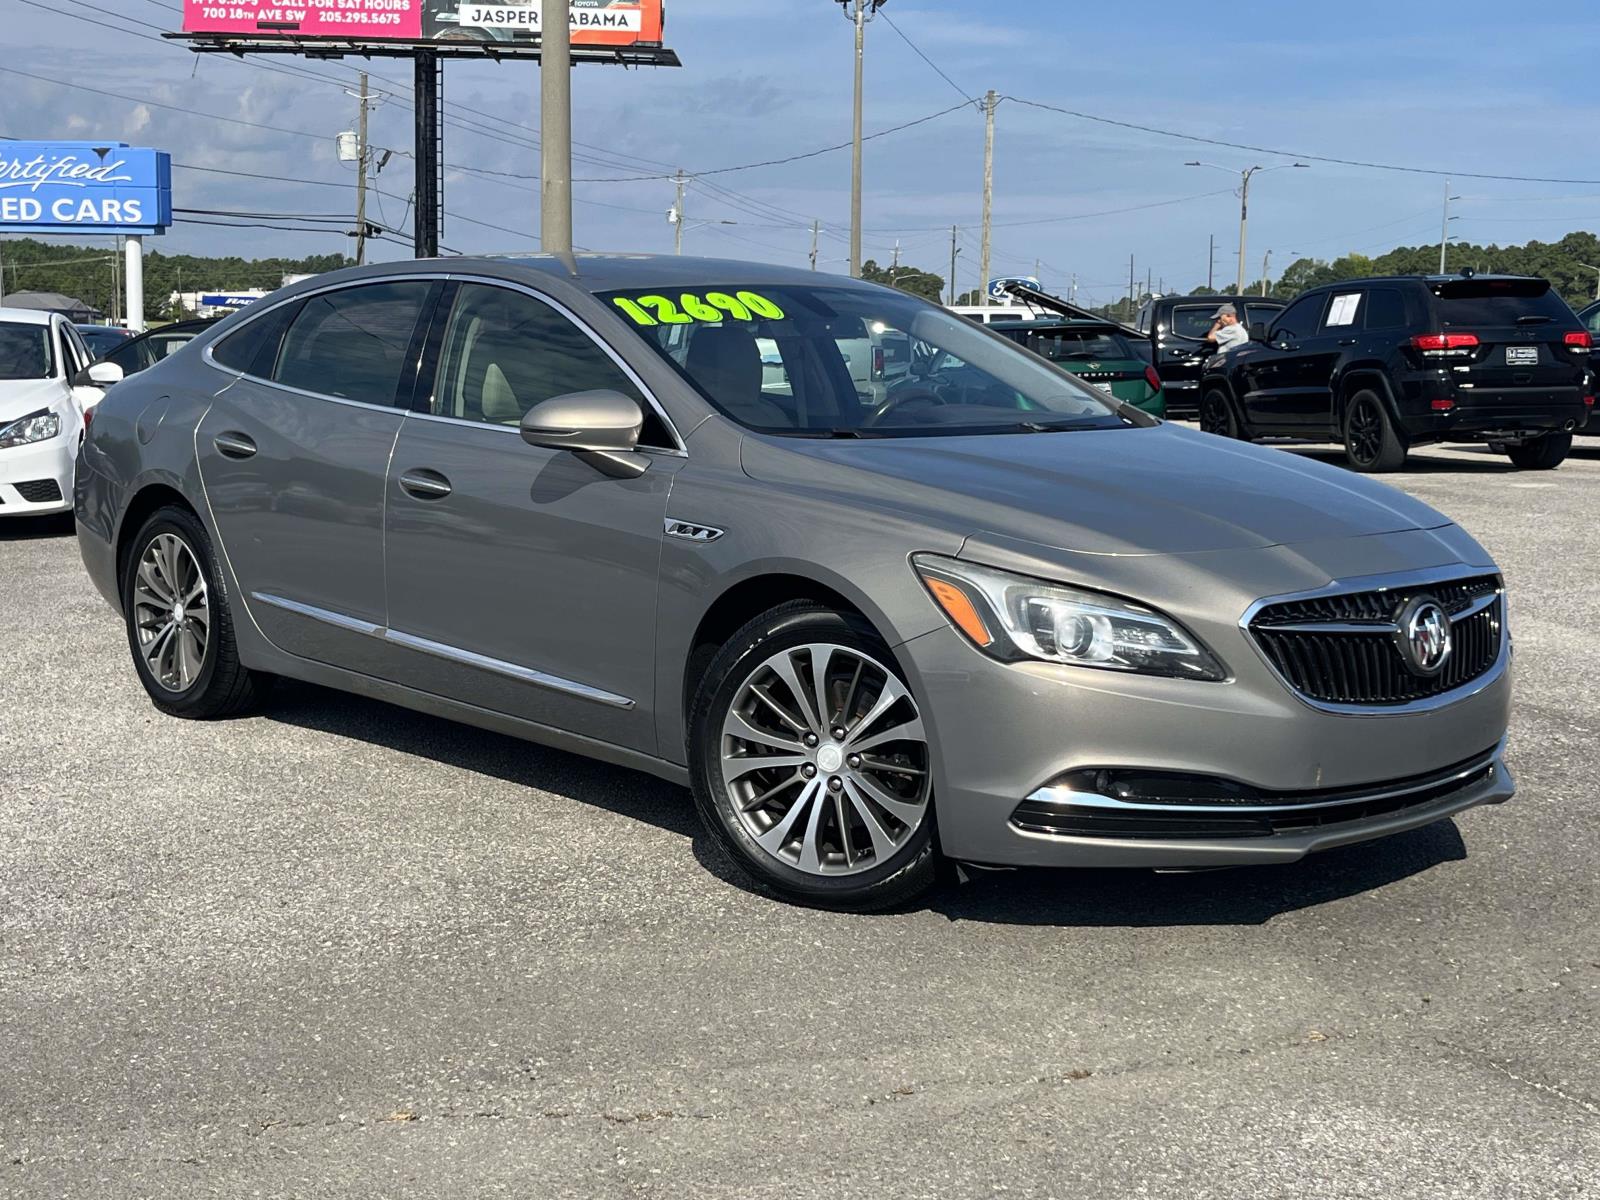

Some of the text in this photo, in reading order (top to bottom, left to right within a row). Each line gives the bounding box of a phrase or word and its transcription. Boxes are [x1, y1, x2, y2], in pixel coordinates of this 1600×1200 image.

[202, 8, 226, 19] 700
[257, 9, 282, 20] AVE
[285, 10, 306, 21] SW
[319, 11, 400, 24] 205.295.5675
[308, 0, 334, 8] FOR
[337, 0, 361, 9] SAT
[364, 0, 410, 10] HOURS
[471, 9, 629, 27] JASPER ABAMA
[0, 154, 132, 193] ertified
[0, 197, 143, 223] ED CARS
[613, 291, 785, 325] 12690
